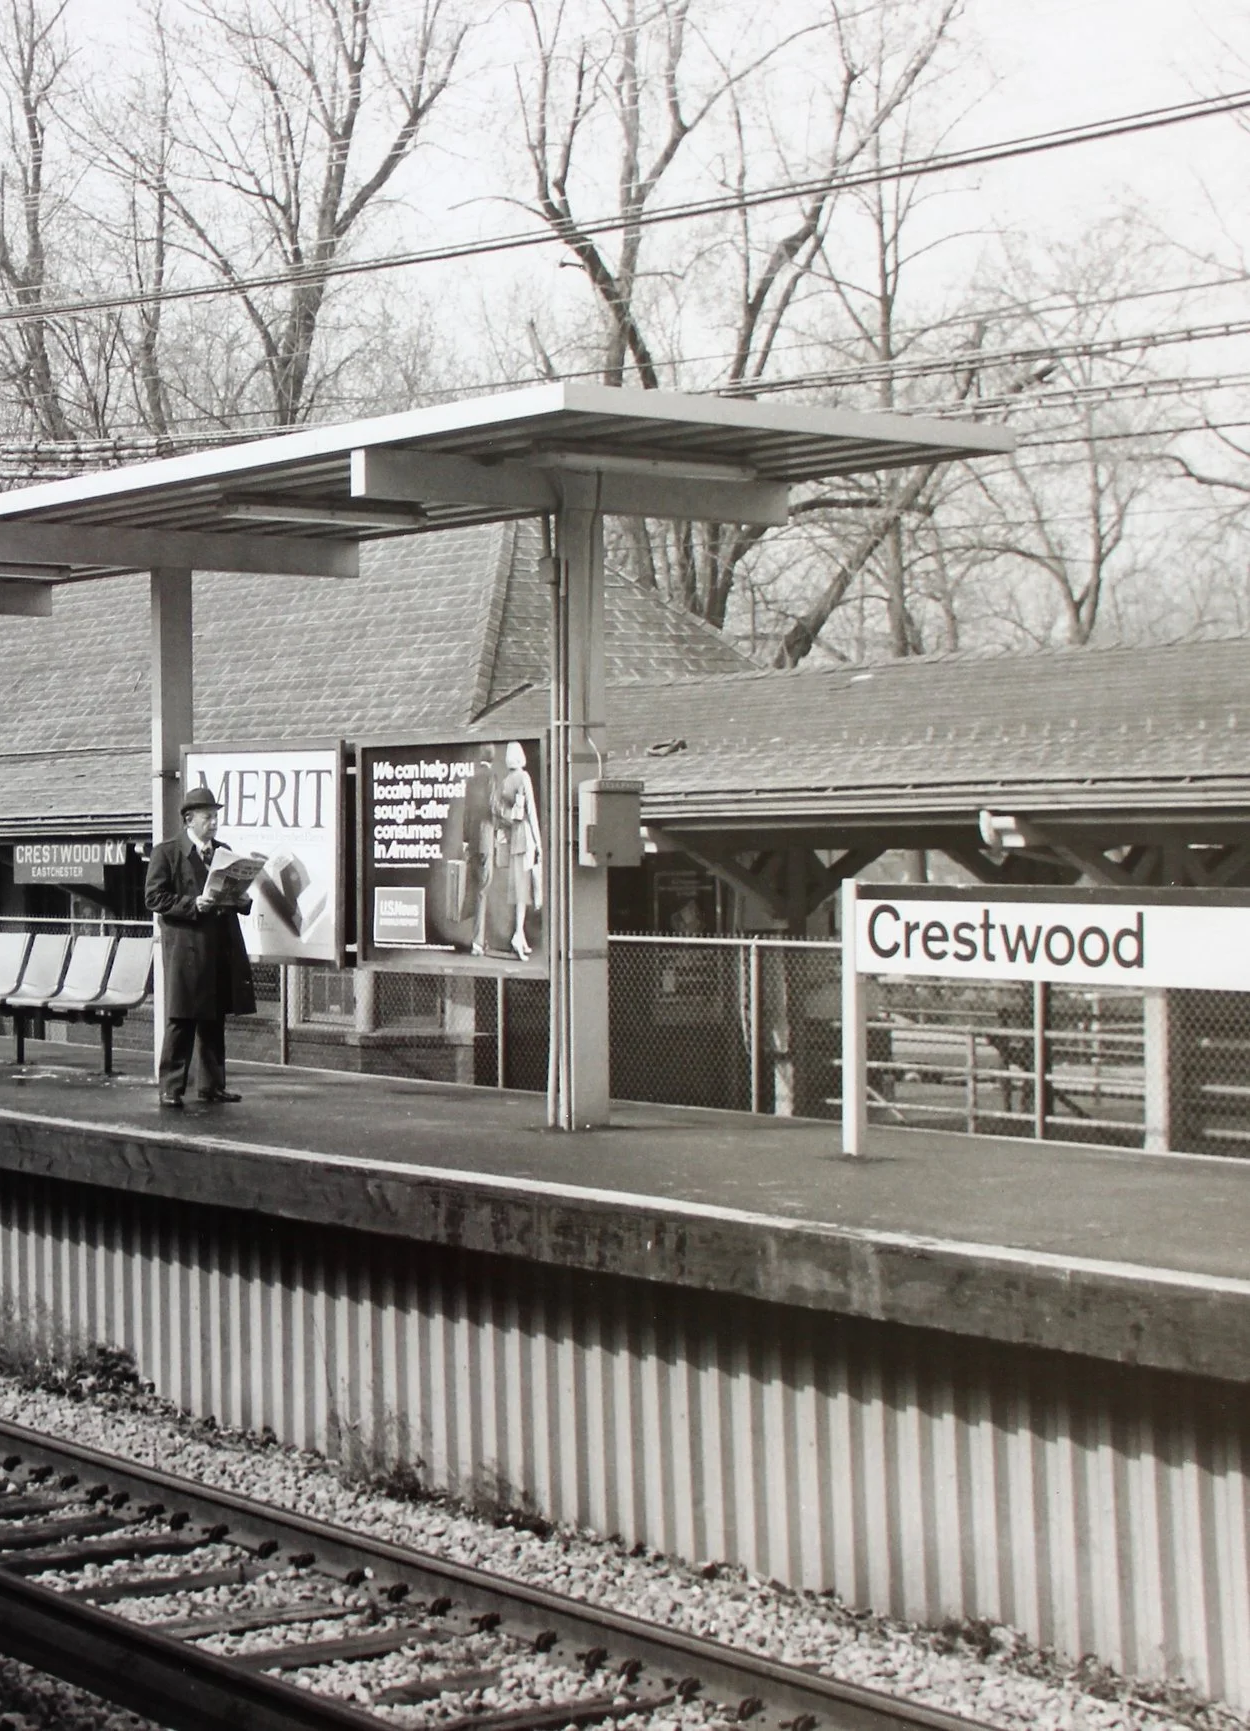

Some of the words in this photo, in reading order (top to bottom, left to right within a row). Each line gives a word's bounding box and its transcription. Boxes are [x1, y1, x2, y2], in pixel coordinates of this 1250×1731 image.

[373, 761, 394, 780] We
[395, 764, 419, 779] can
[420, 760, 448, 781] help
[449, 761, 475, 781] you
[196, 769, 332, 828] MERIT
[374, 781, 411, 800] locate
[412, 780, 433, 799] the
[434, 779, 466, 798] most
[374, 800, 450, 824] sought-after
[374, 824, 443, 840] consumers
[15, 844, 101, 864] CRESTWOOD
[374, 840, 386, 859] in
[387, 840, 443, 859] America.
[31, 866, 84, 878] EASTCHESTER
[867, 904, 1145, 969] Crestwood
